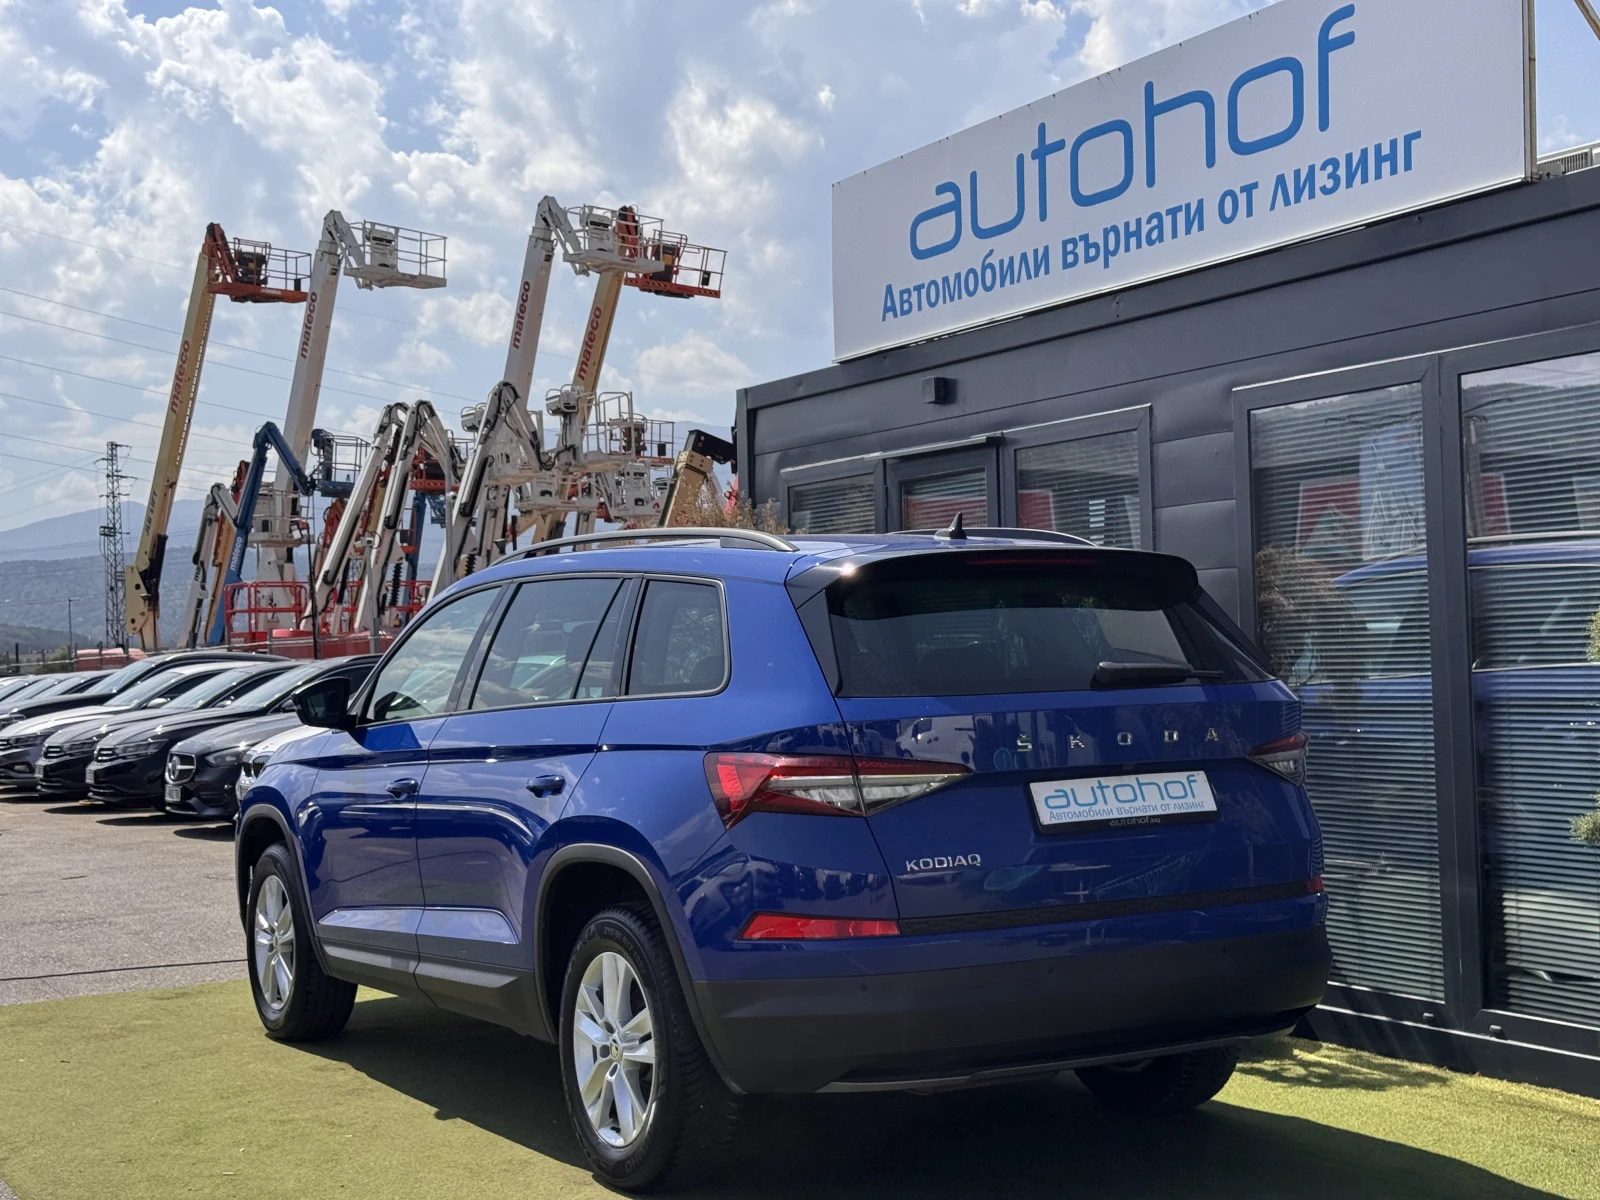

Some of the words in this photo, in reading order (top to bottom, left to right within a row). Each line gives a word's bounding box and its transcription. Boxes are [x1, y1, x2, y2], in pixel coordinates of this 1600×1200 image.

[910, 3, 1355, 260] autohof
[881, 249, 1050, 322] Автомобили
[1062, 198, 1204, 269] върнати
[1217, 181, 1259, 225] от
[1269, 130, 1422, 212] лизинг
[300, 291, 318, 360] mateco
[512, 281, 531, 350] mateco
[578, 306, 602, 381] mateco
[170, 340, 190, 414] mateco
[230, 536, 243, 572] mateco
[1017, 727, 1224, 752] ŠKODA
[1044, 774, 1199, 809] autohof
[1050, 806, 1114, 821] Автомобили
[1118, 804, 1158, 817] върнати
[1161, 803, 1171, 812] от
[1173, 801, 1205, 812] лизинг
[905, 853, 981, 872] KODIAQ
